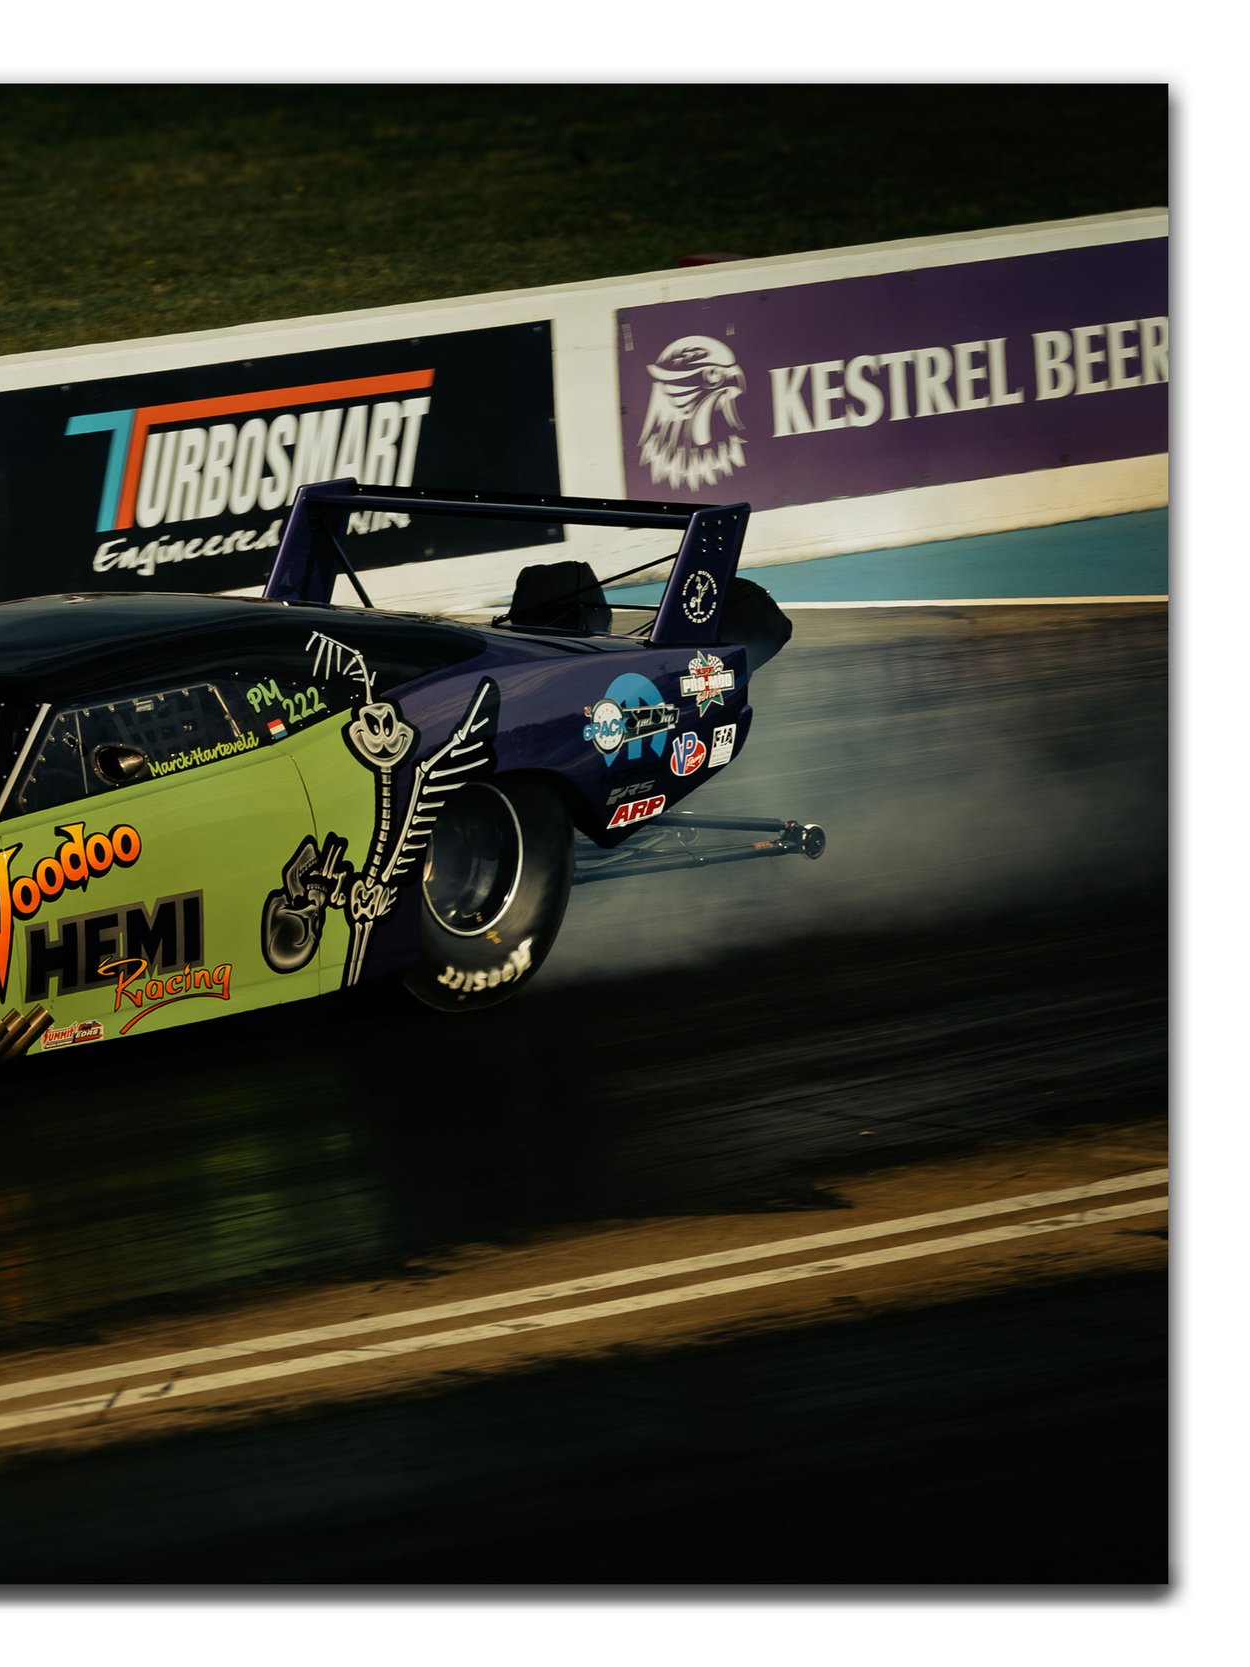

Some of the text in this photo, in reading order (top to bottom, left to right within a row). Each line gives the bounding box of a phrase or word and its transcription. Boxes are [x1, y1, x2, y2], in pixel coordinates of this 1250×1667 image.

[768, 316, 1169, 438] KESTREL BEER
[65, 368, 436, 533] TURBOSMART
[93, 519, 284, 577] Engineered
[246, 679, 284, 713] PM
[282, 686, 327, 724] 222
[147, 731, 260, 778] Marck Harteveld
[672, 731, 699, 776] VP
[610, 795, 665, 826] ARP
[24, 888, 205, 1004] HEMI
[96, 955, 233, 1034] Racing
